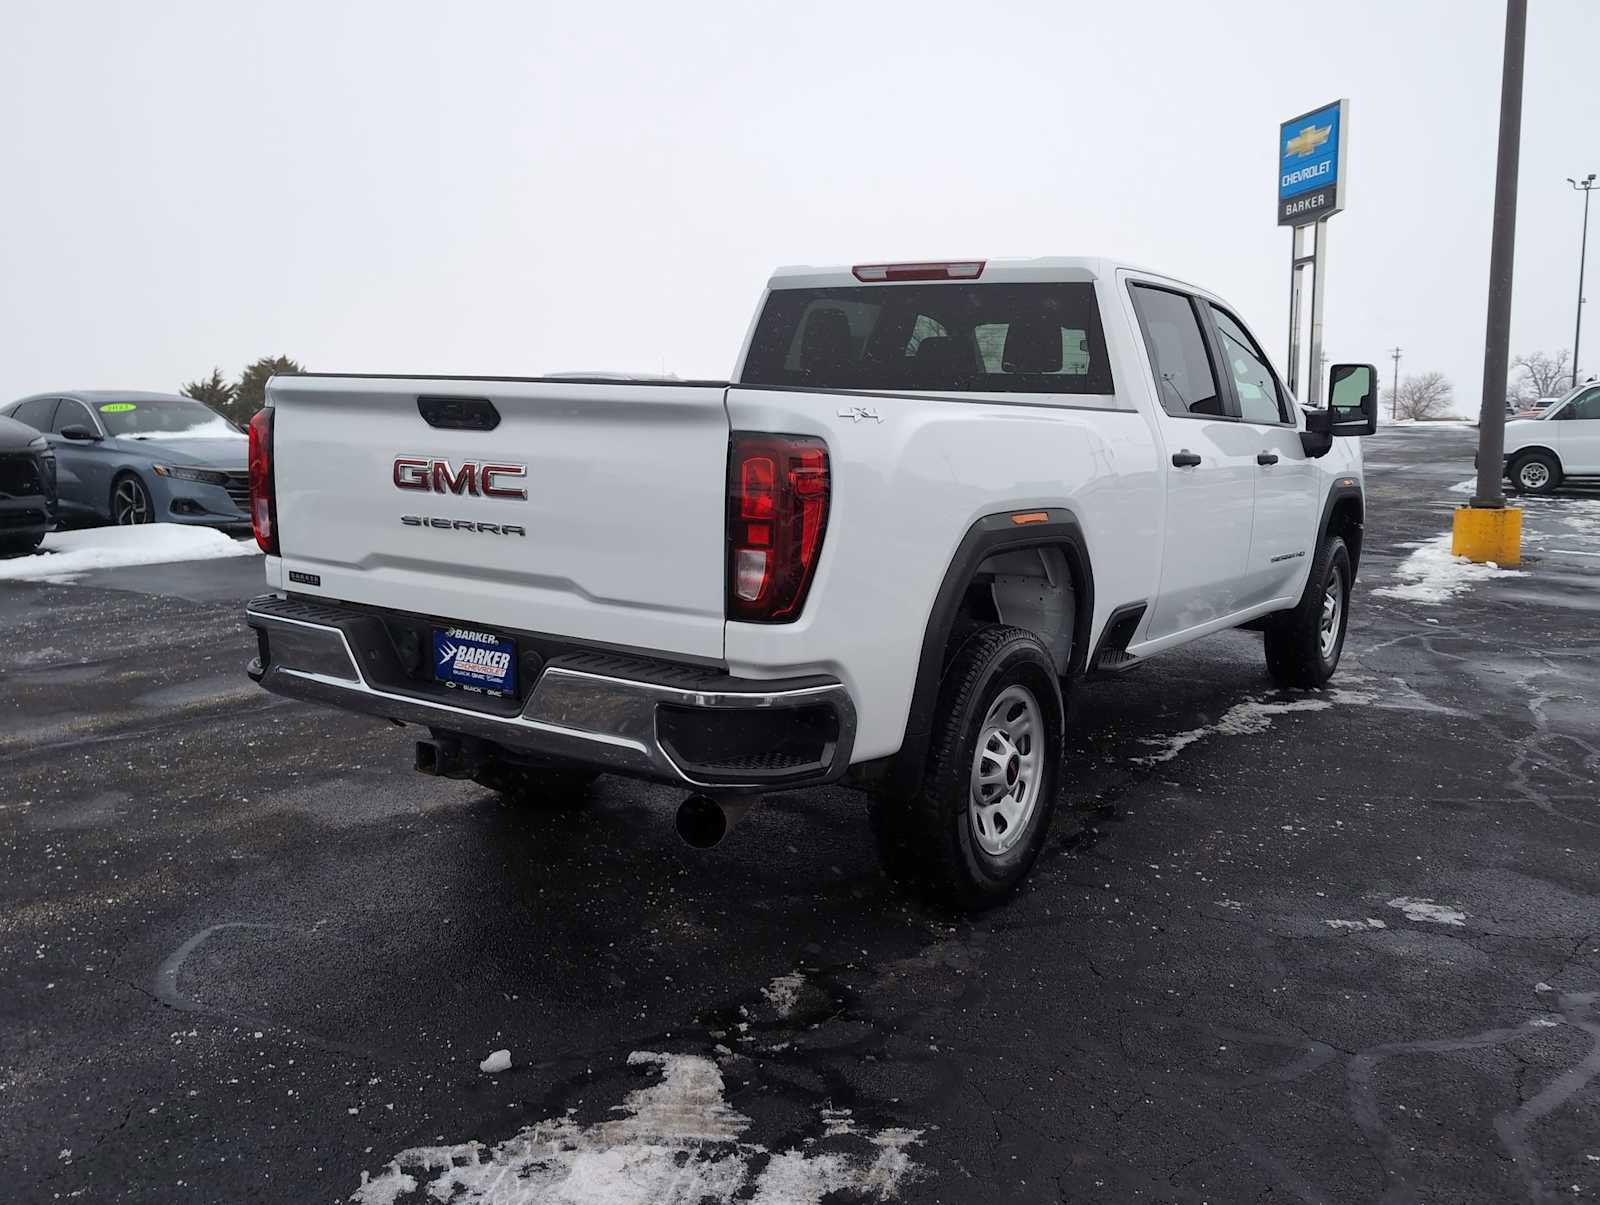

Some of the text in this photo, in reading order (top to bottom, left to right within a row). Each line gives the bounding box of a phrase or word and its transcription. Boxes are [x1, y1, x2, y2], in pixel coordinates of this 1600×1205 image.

[1282, 160, 1331, 187] CHEVROLET
[1286, 194, 1325, 215] BARKER
[393, 457, 528, 501] GMC
[400, 515, 526, 536] SIERRA
[454, 629, 496, 644] BARKER
[455, 645, 511, 669] BARKER
